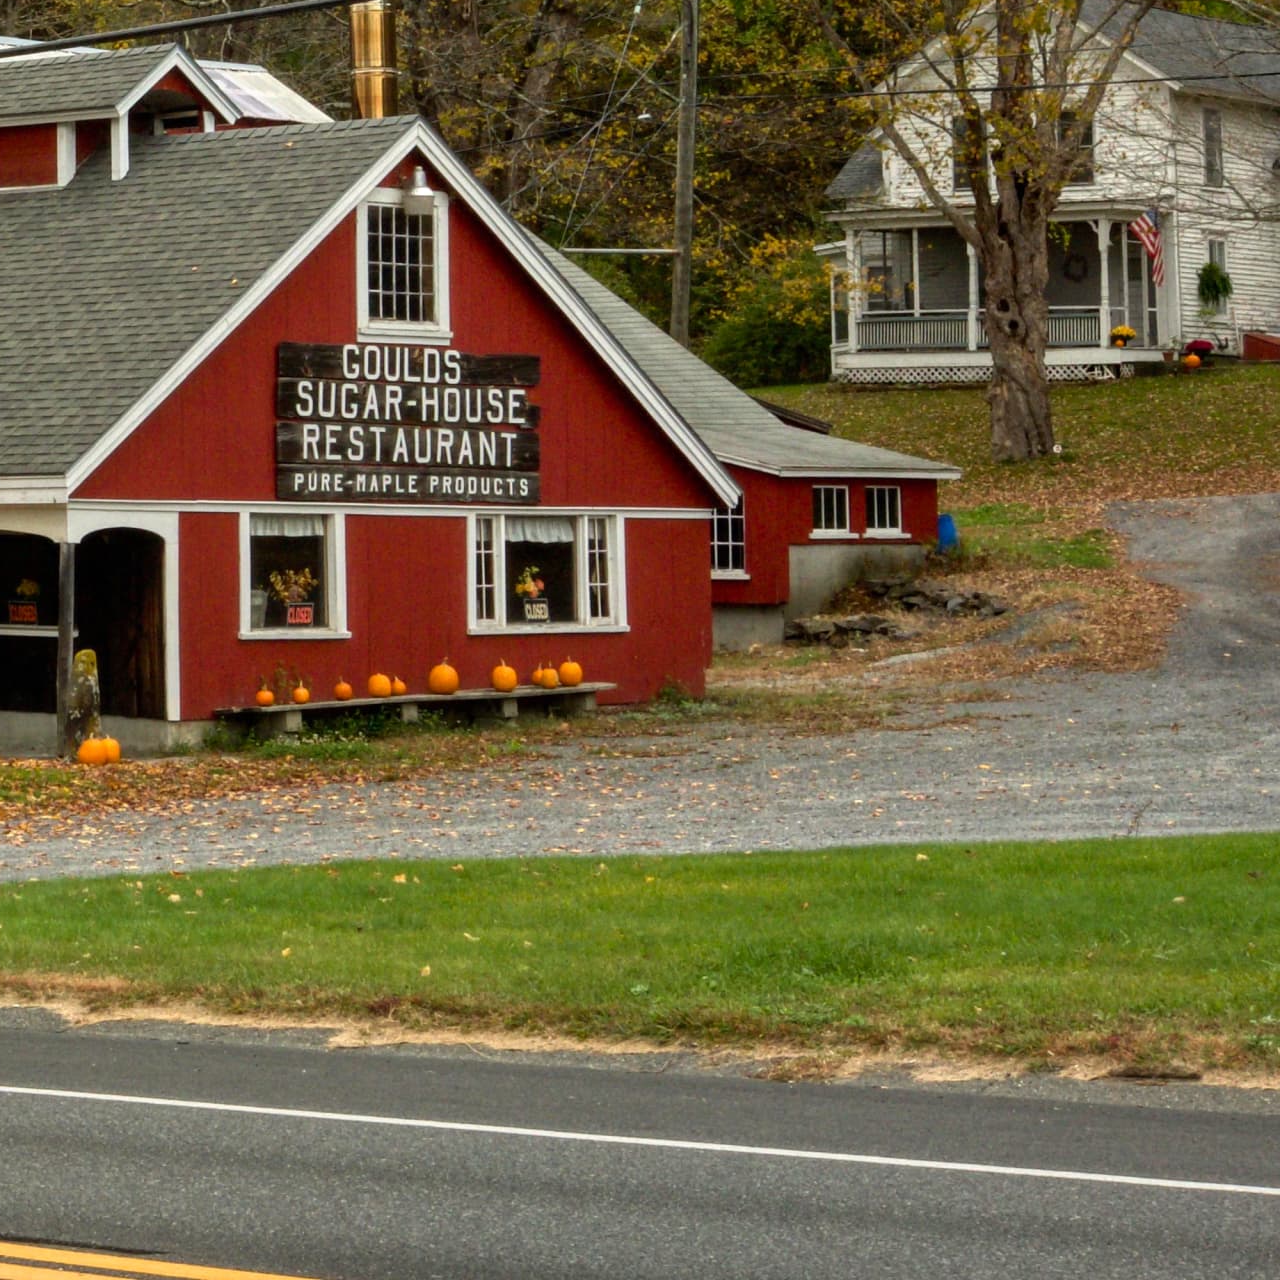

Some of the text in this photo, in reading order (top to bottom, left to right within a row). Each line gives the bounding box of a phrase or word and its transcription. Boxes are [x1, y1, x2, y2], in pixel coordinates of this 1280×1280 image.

[342, 344, 461, 384] GOULDS
[296, 381, 526, 424] SUGAR-HOUSE
[303, 424, 517, 467] RESTAURANT
[294, 472, 529, 497] PURE-MAPLE PRODUCTS
[288, 607, 312, 624] CLOSED
[525, 603, 548, 619] CLOSED
